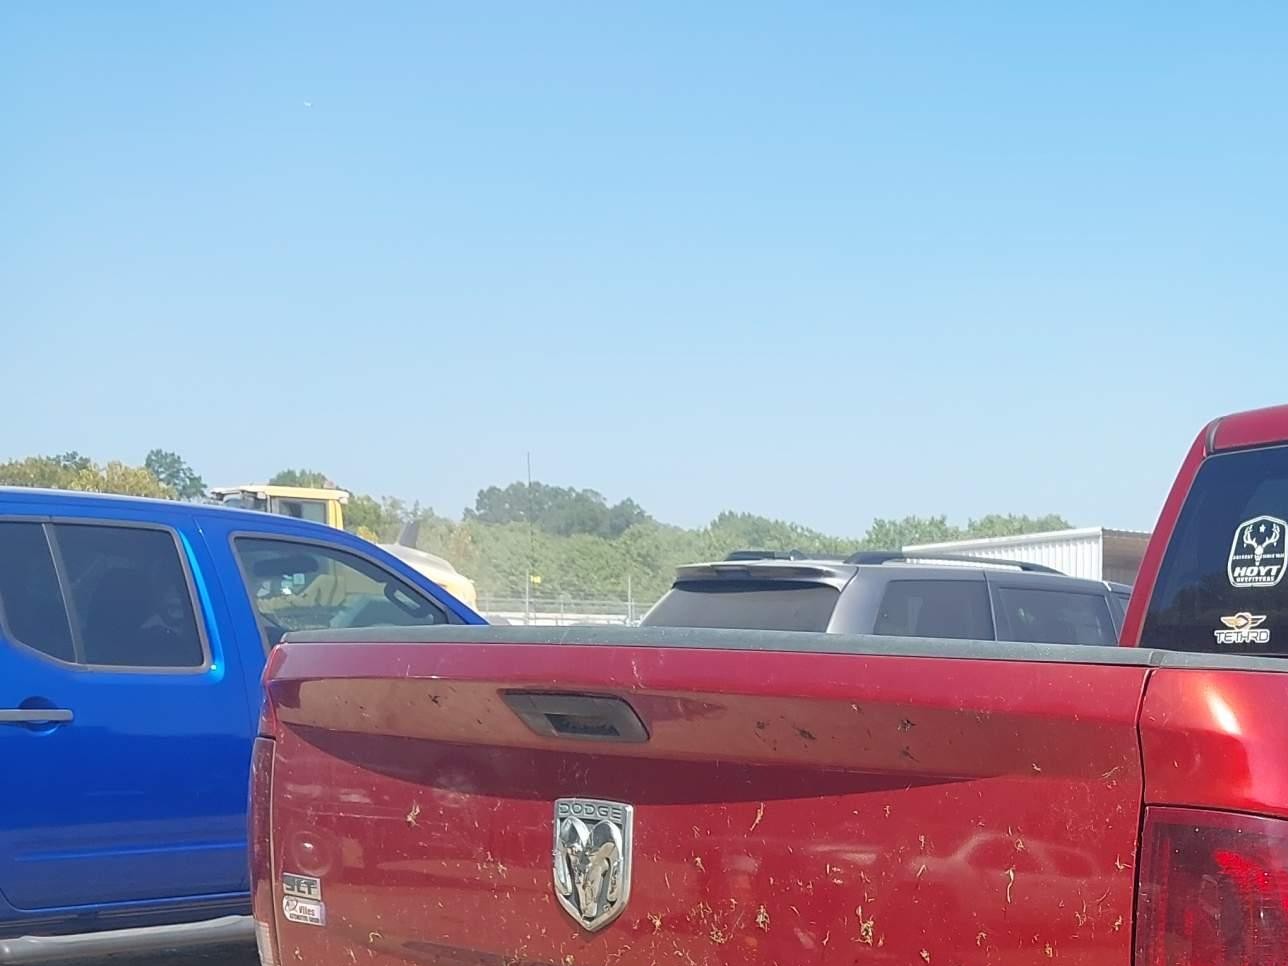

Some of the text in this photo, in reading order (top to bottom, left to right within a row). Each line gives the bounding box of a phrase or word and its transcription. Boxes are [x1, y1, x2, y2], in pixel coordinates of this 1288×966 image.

[1233, 565, 1281, 577] HOYT
[1215, 630, 1270, 643] TETHRD
[558, 802, 623, 821] DODGE
